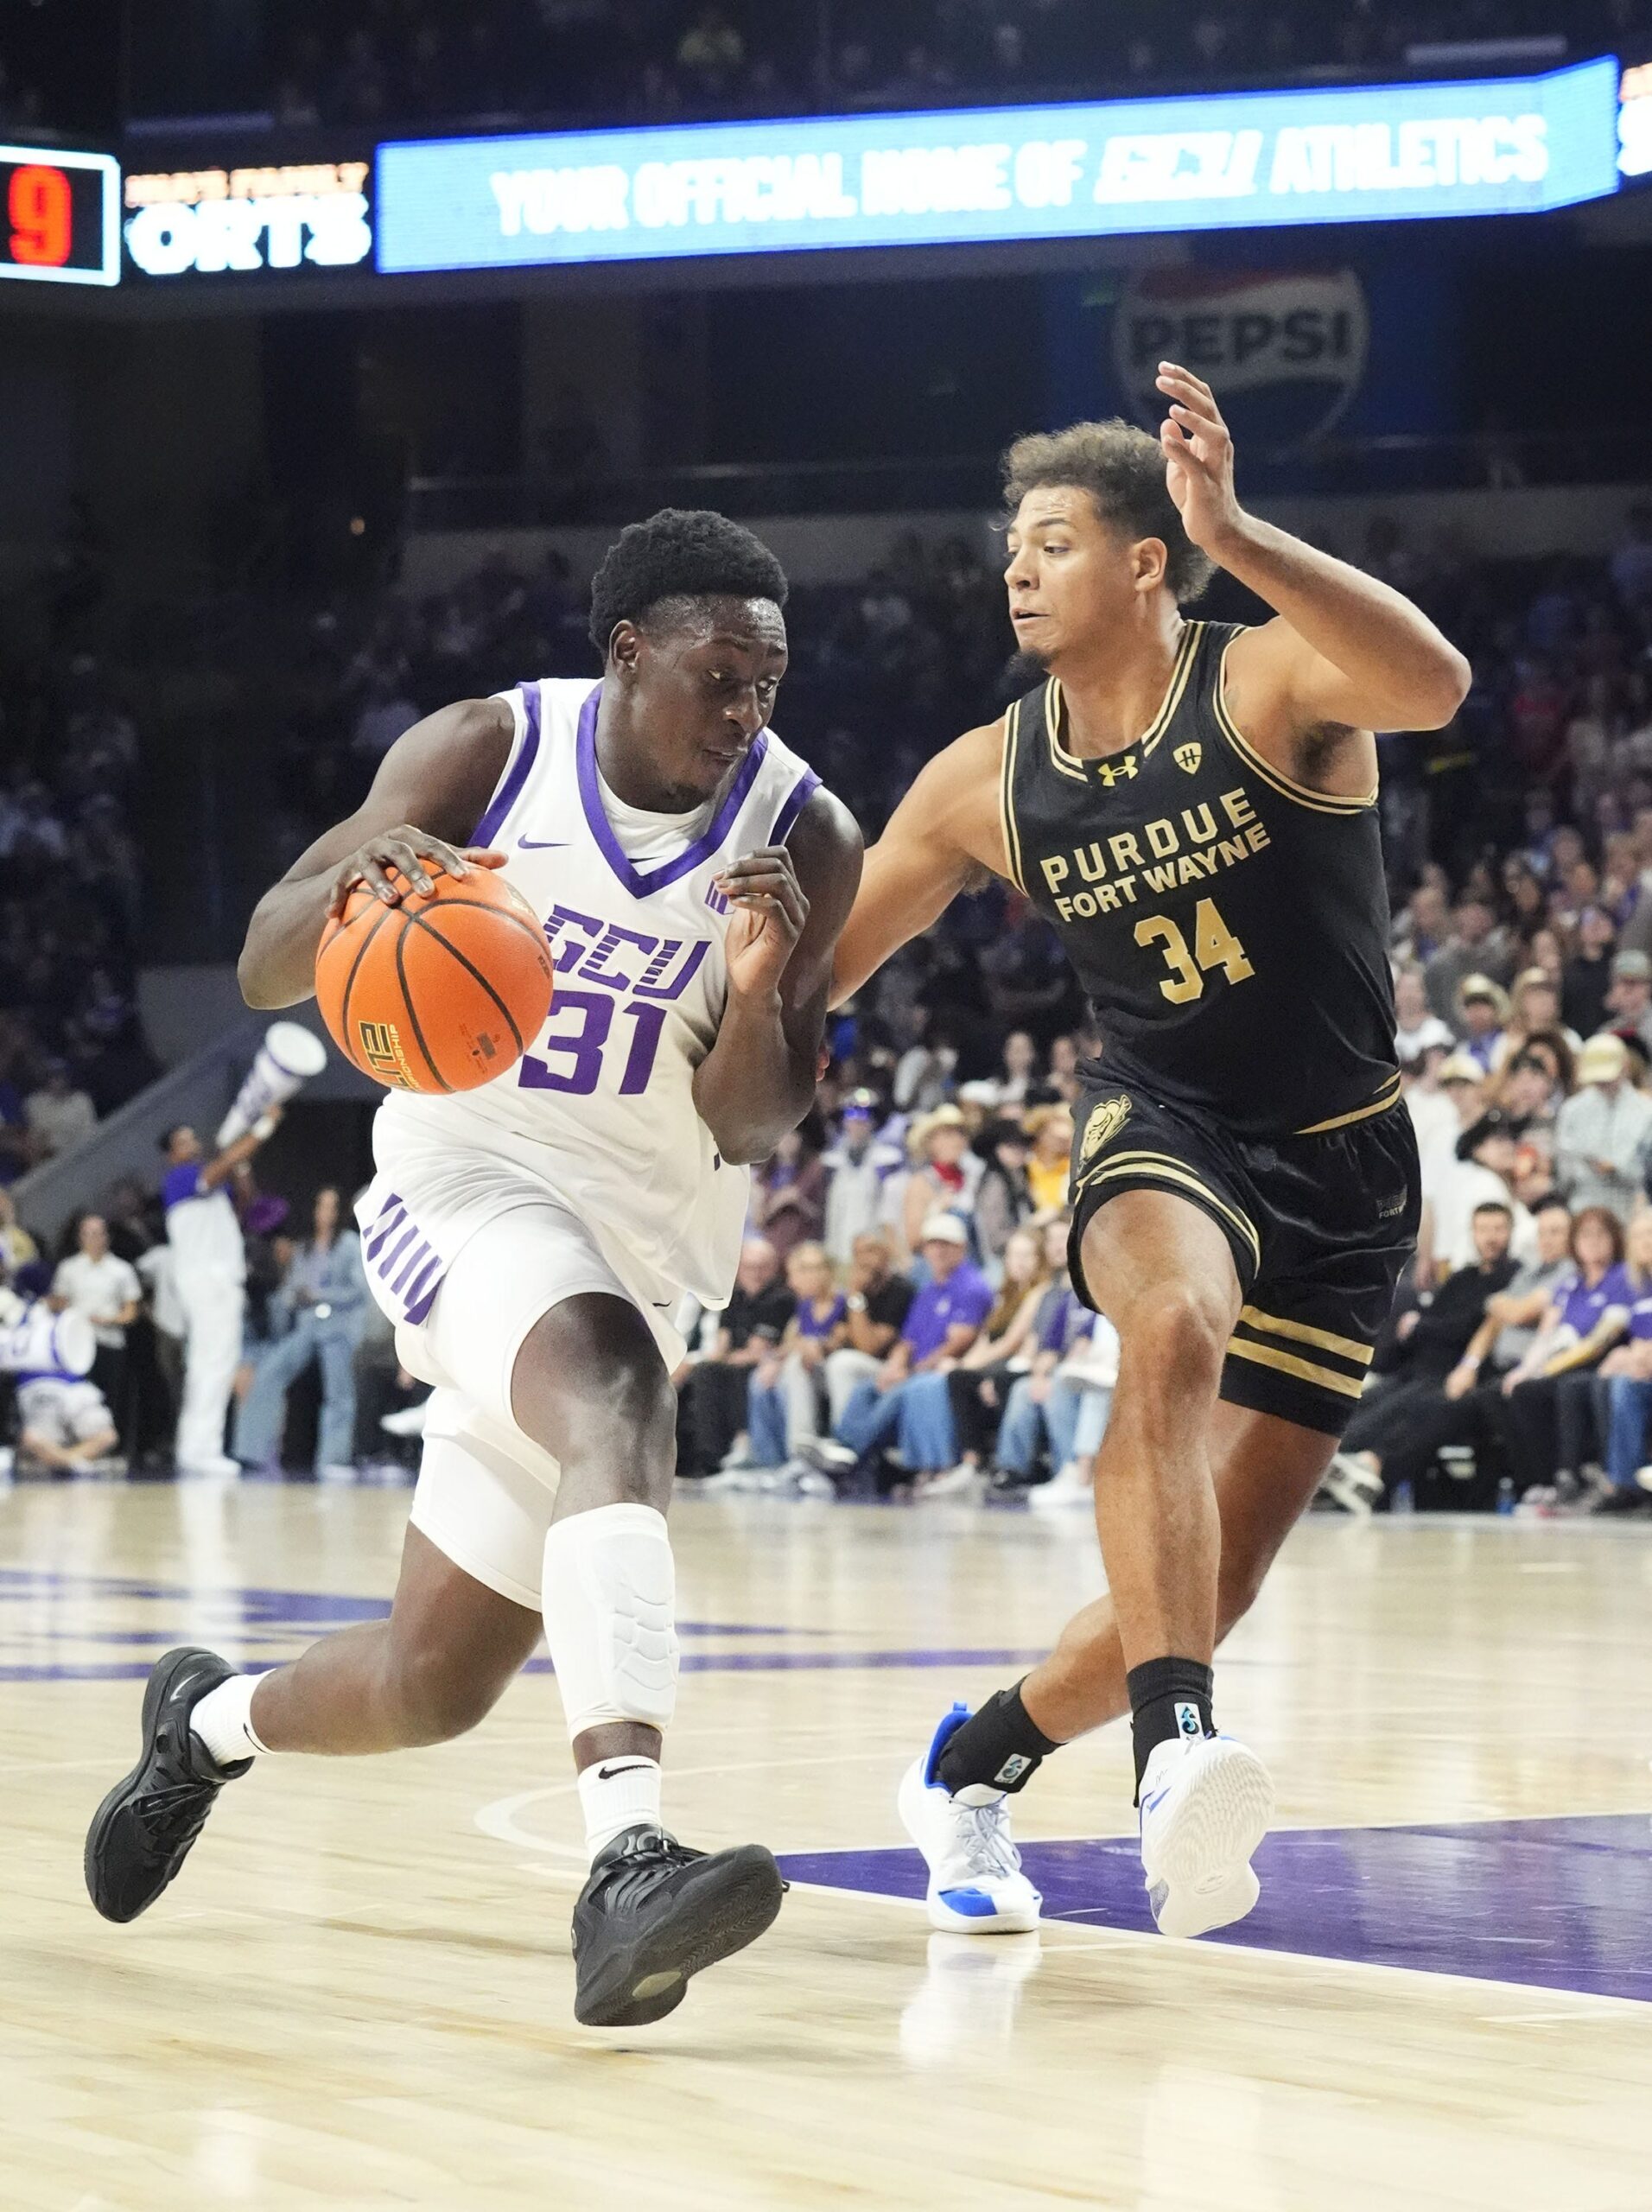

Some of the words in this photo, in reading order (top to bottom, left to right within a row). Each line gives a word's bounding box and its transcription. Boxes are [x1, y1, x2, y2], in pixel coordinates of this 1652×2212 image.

[9, 163, 73, 268] 9
[490, 165, 629, 236] YOUR
[633, 152, 857, 229] OFFICIAL
[1014, 139, 1087, 207] OF
[1270, 114, 1548, 194] ATHLETICS
[124, 193, 372, 275] ORTS
[1128, 306, 1351, 365] PEPSI
[1040, 787, 1256, 893] PURDUE
[1055, 875, 1137, 922] FORT
[1142, 822, 1271, 893] WAYNE
[543, 904, 712, 1000] GCU
[1134, 898, 1255, 1004] 34
[518, 990, 667, 1096] 31
